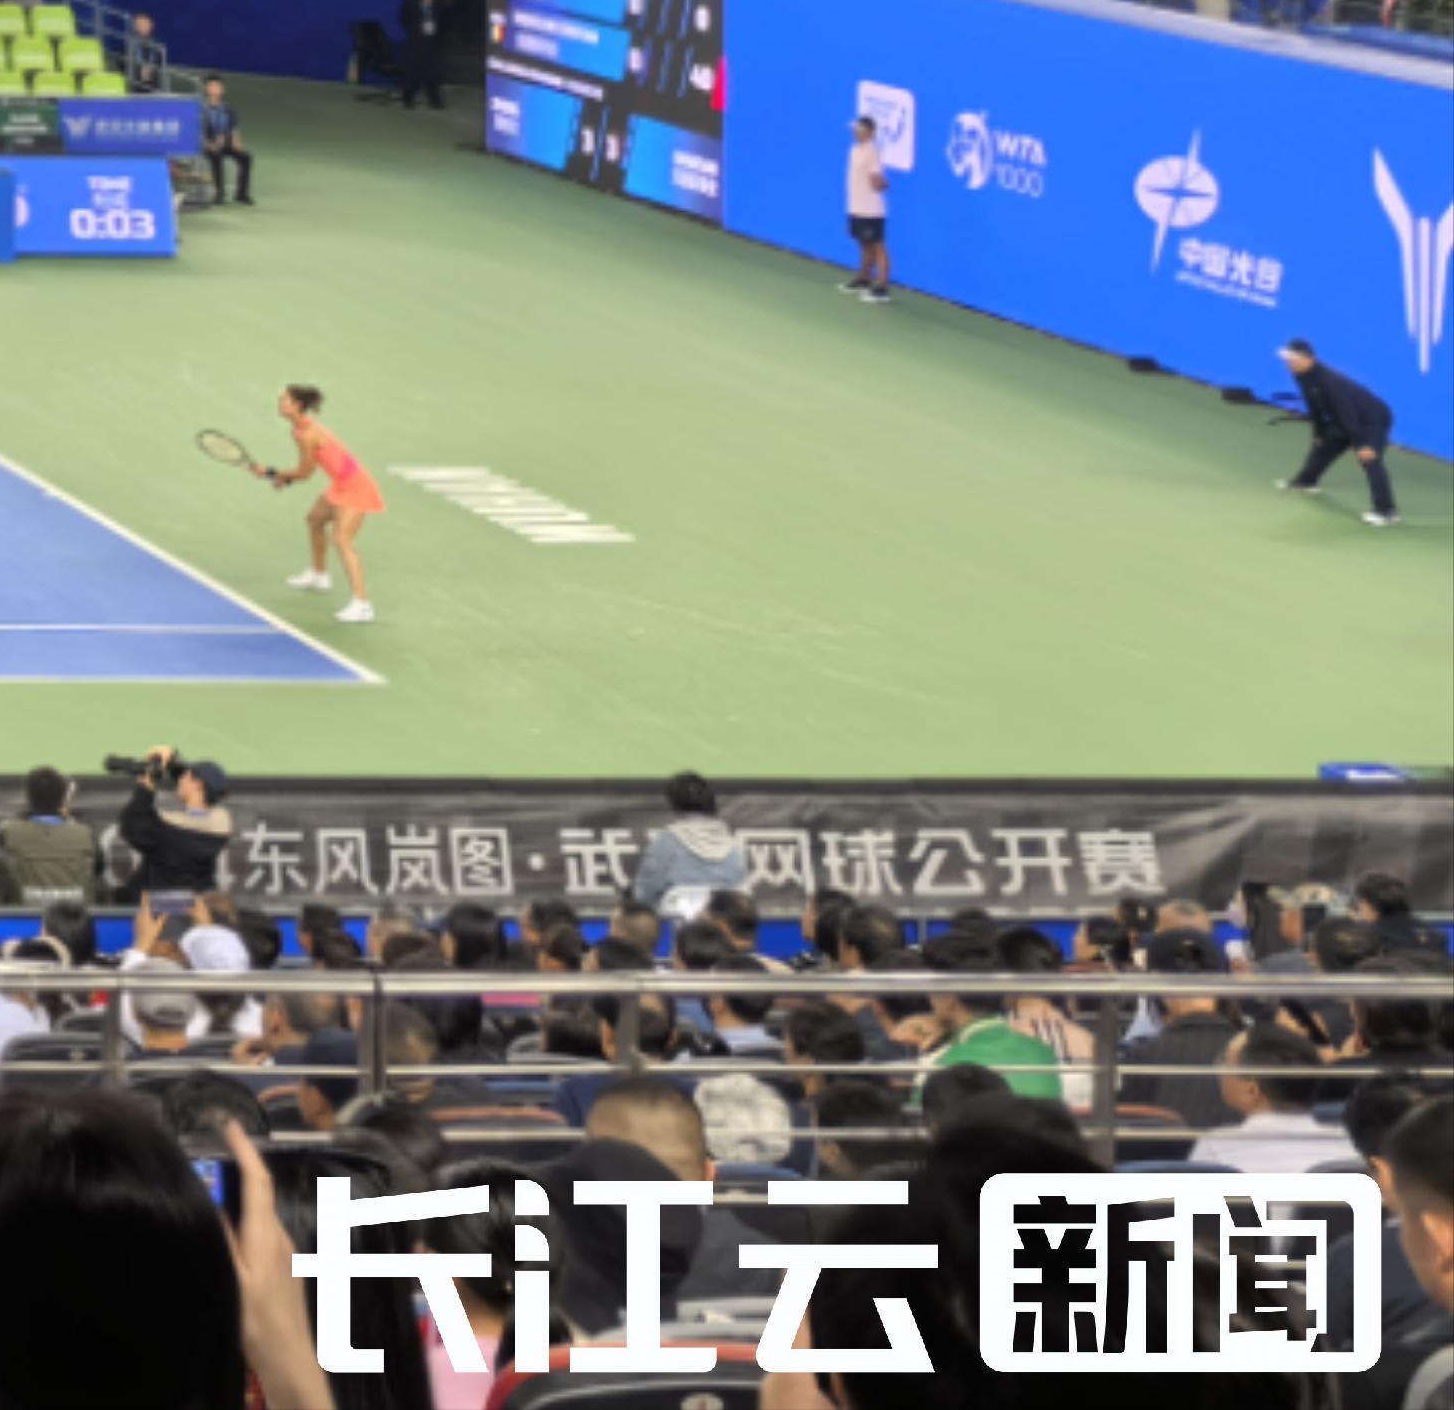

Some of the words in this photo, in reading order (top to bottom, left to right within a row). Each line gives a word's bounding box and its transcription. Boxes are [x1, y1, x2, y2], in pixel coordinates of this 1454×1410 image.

[996, 130, 1047, 165] WTA
[69, 208, 155, 239] 0:03
[1177, 236, 1284, 295] 中国光谷
